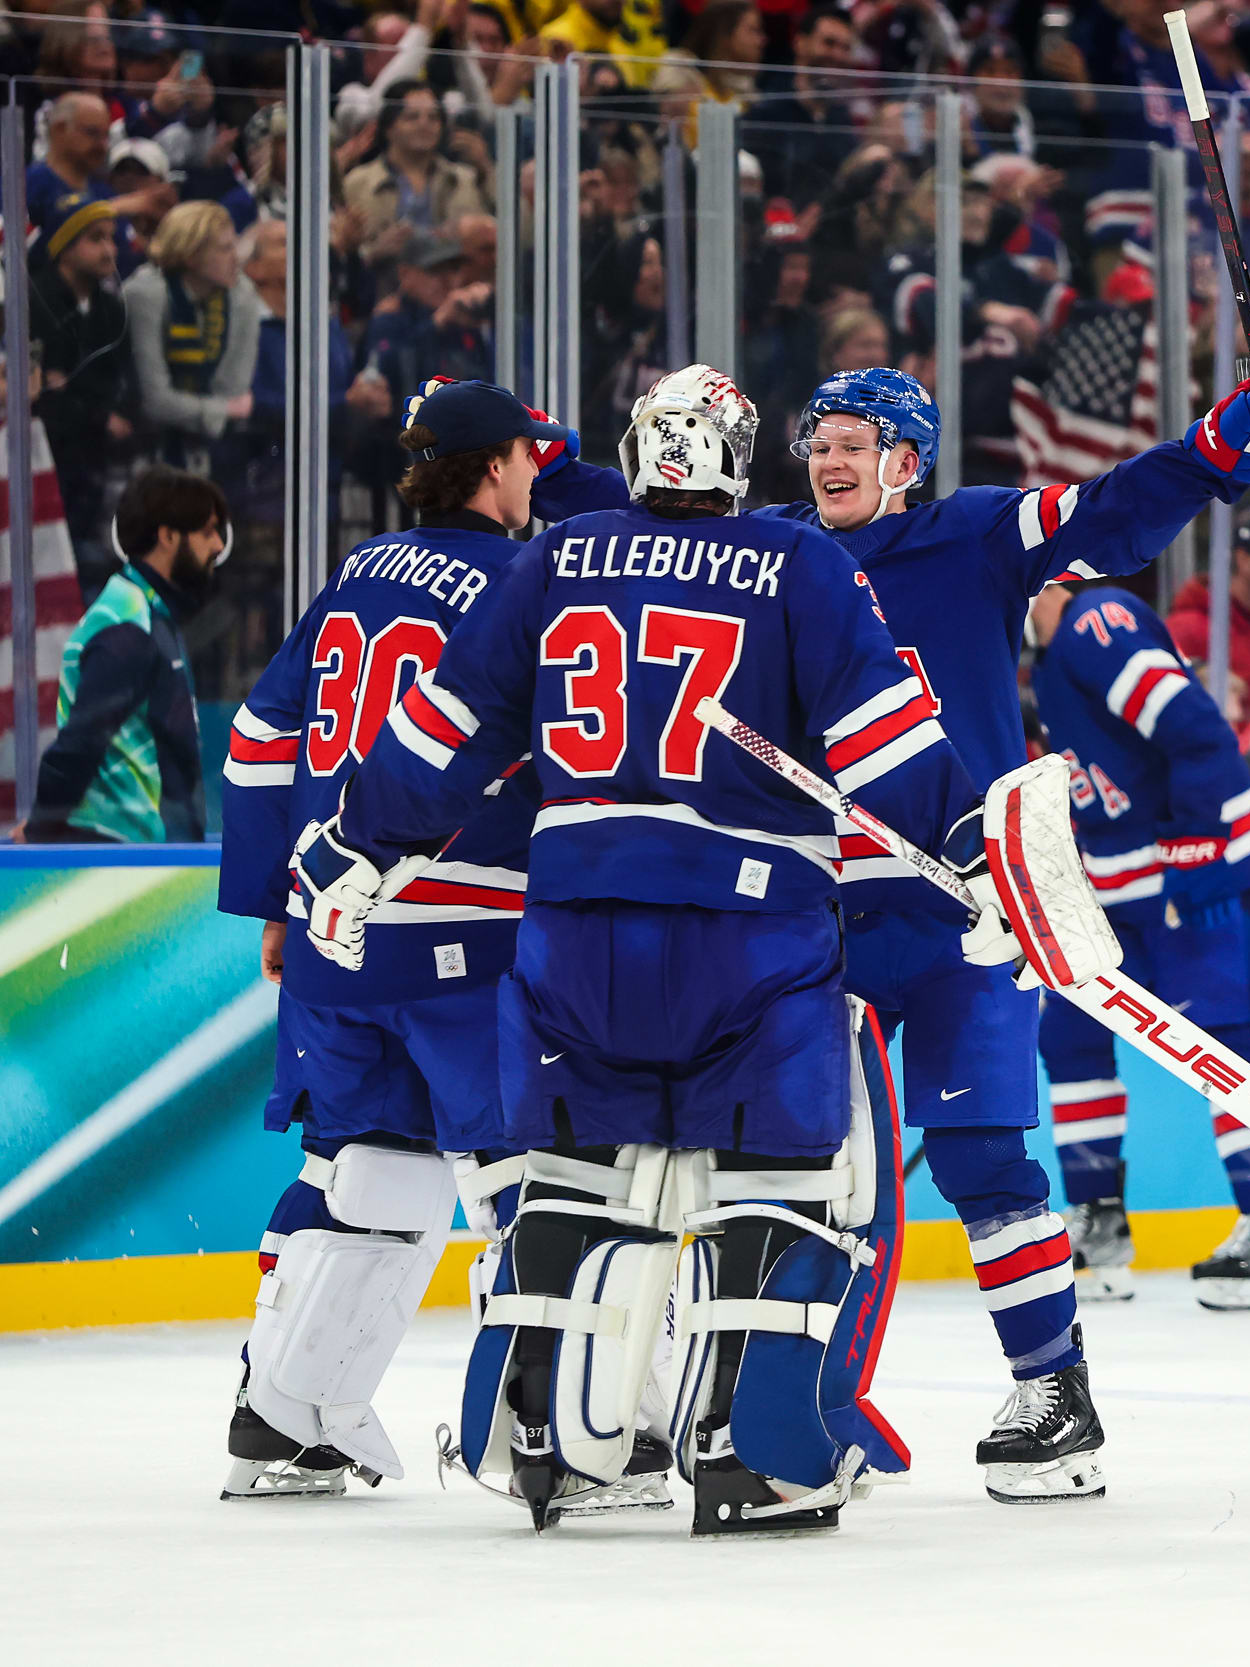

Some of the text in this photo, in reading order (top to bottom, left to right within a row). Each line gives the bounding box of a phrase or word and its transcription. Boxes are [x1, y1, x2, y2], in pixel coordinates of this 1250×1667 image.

[910, 411, 935, 431] BAUER
[552, 534, 785, 598] ELLEBUYCK
[1073, 601, 1139, 647] 74
[306, 610, 449, 777] 30
[540, 604, 746, 782] 37
[1060, 747, 1132, 820] SA
[845, 1236, 888, 1369] TRUE
[527, 1427, 543, 1438] 37
